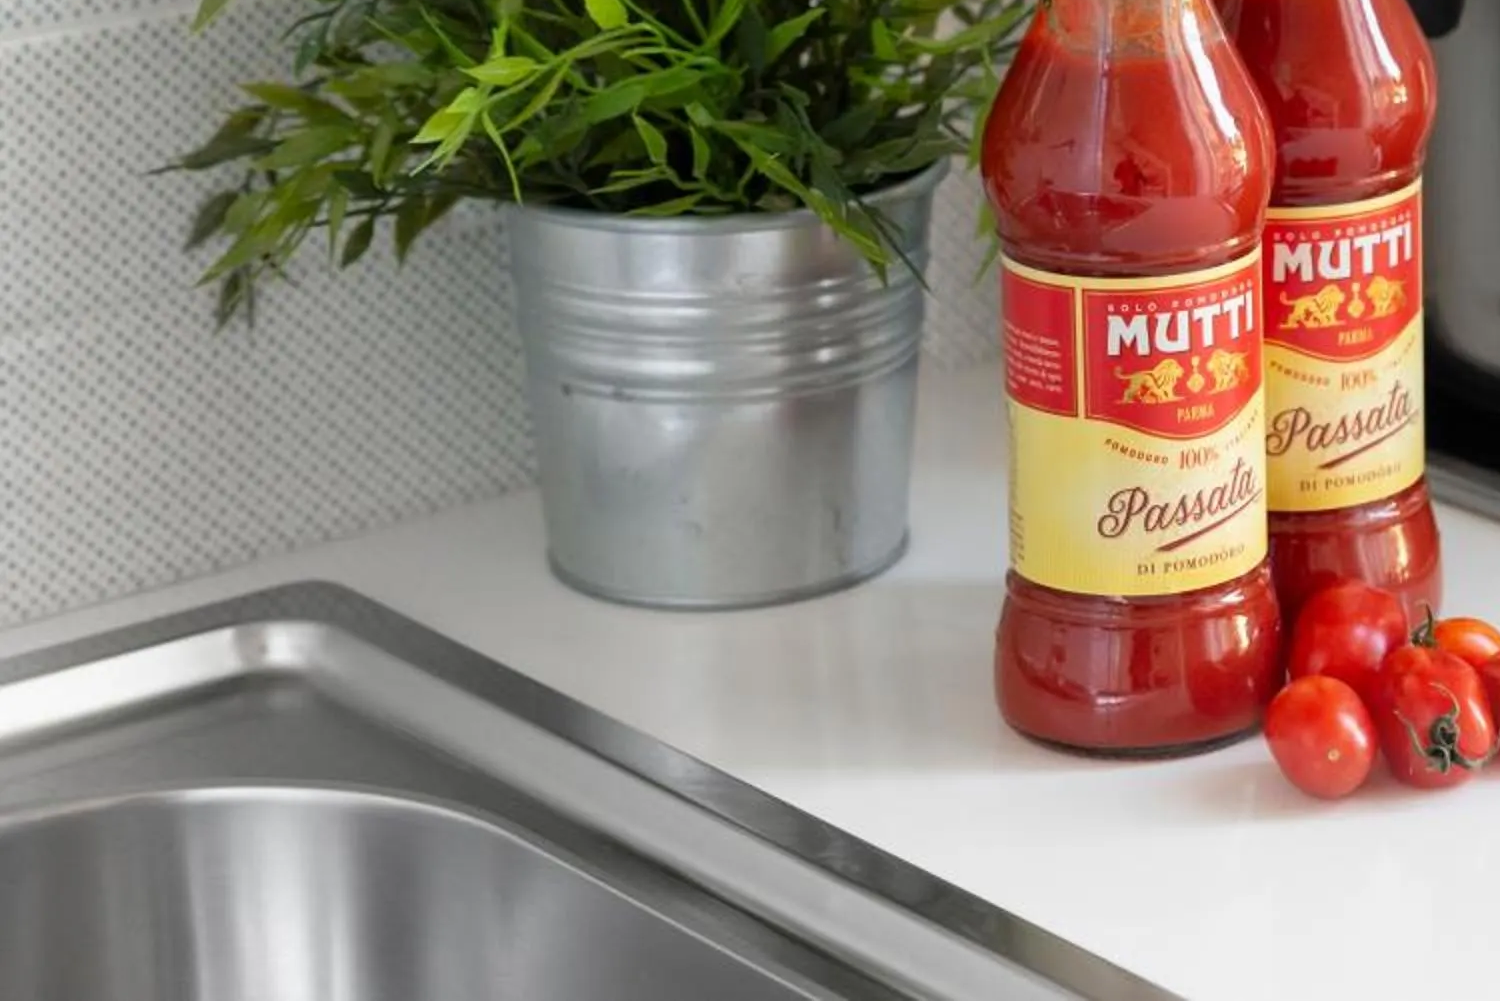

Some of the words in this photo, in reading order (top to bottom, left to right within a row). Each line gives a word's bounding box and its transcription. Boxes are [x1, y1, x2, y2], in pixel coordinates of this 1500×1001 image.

[1272, 220, 1412, 283] MUTTI
[1106, 289, 1254, 357] MUTTI
[1107, 302, 1158, 313] SOLO
[1176, 403, 1215, 425] PARMA
[1265, 379, 1411, 457] Passata
[1097, 456, 1257, 539] Passata
[1300, 480, 1317, 493] DI
[1136, 562, 1155, 576] DI
[1163, 544, 1246, 575] POMODORO
